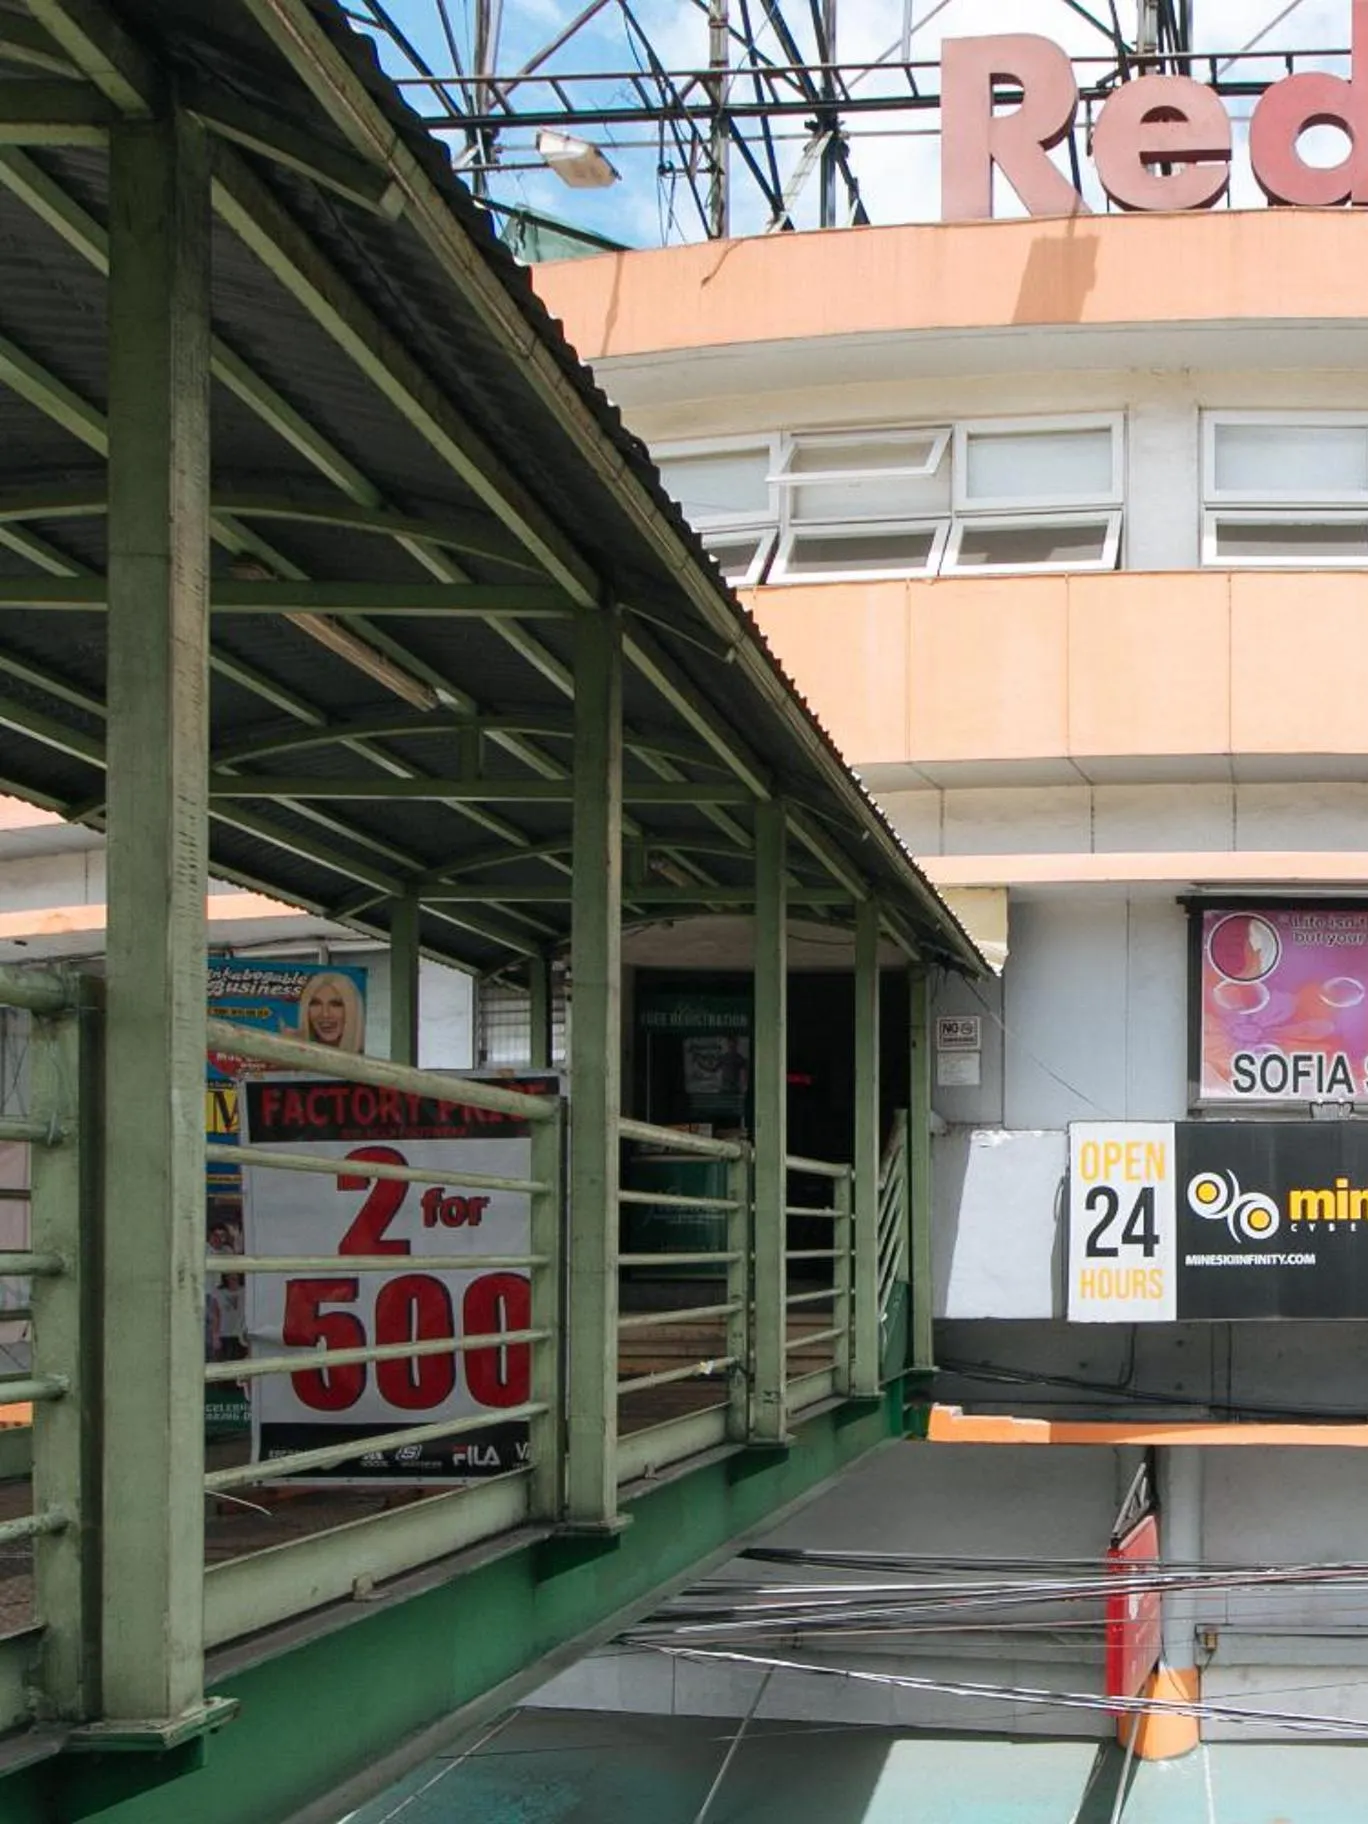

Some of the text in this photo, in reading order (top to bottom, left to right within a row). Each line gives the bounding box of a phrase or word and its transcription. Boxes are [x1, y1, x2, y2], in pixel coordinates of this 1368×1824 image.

[207, 979, 303, 997] Business
[1233, 1053, 1355, 1095] SOFIA
[261, 1085, 422, 1126] FACTORY
[1080, 1140, 1166, 1183] OPEN
[336, 1146, 490, 1257] 2 for
[1085, 1185, 1160, 1258] 24
[1185, 1253, 1316, 1267] MINESKIINFINITY.COM
[1080, 1268, 1163, 1300] HOURS
[283, 1272, 532, 1412] 500
[453, 1445, 501, 1467] FILA
